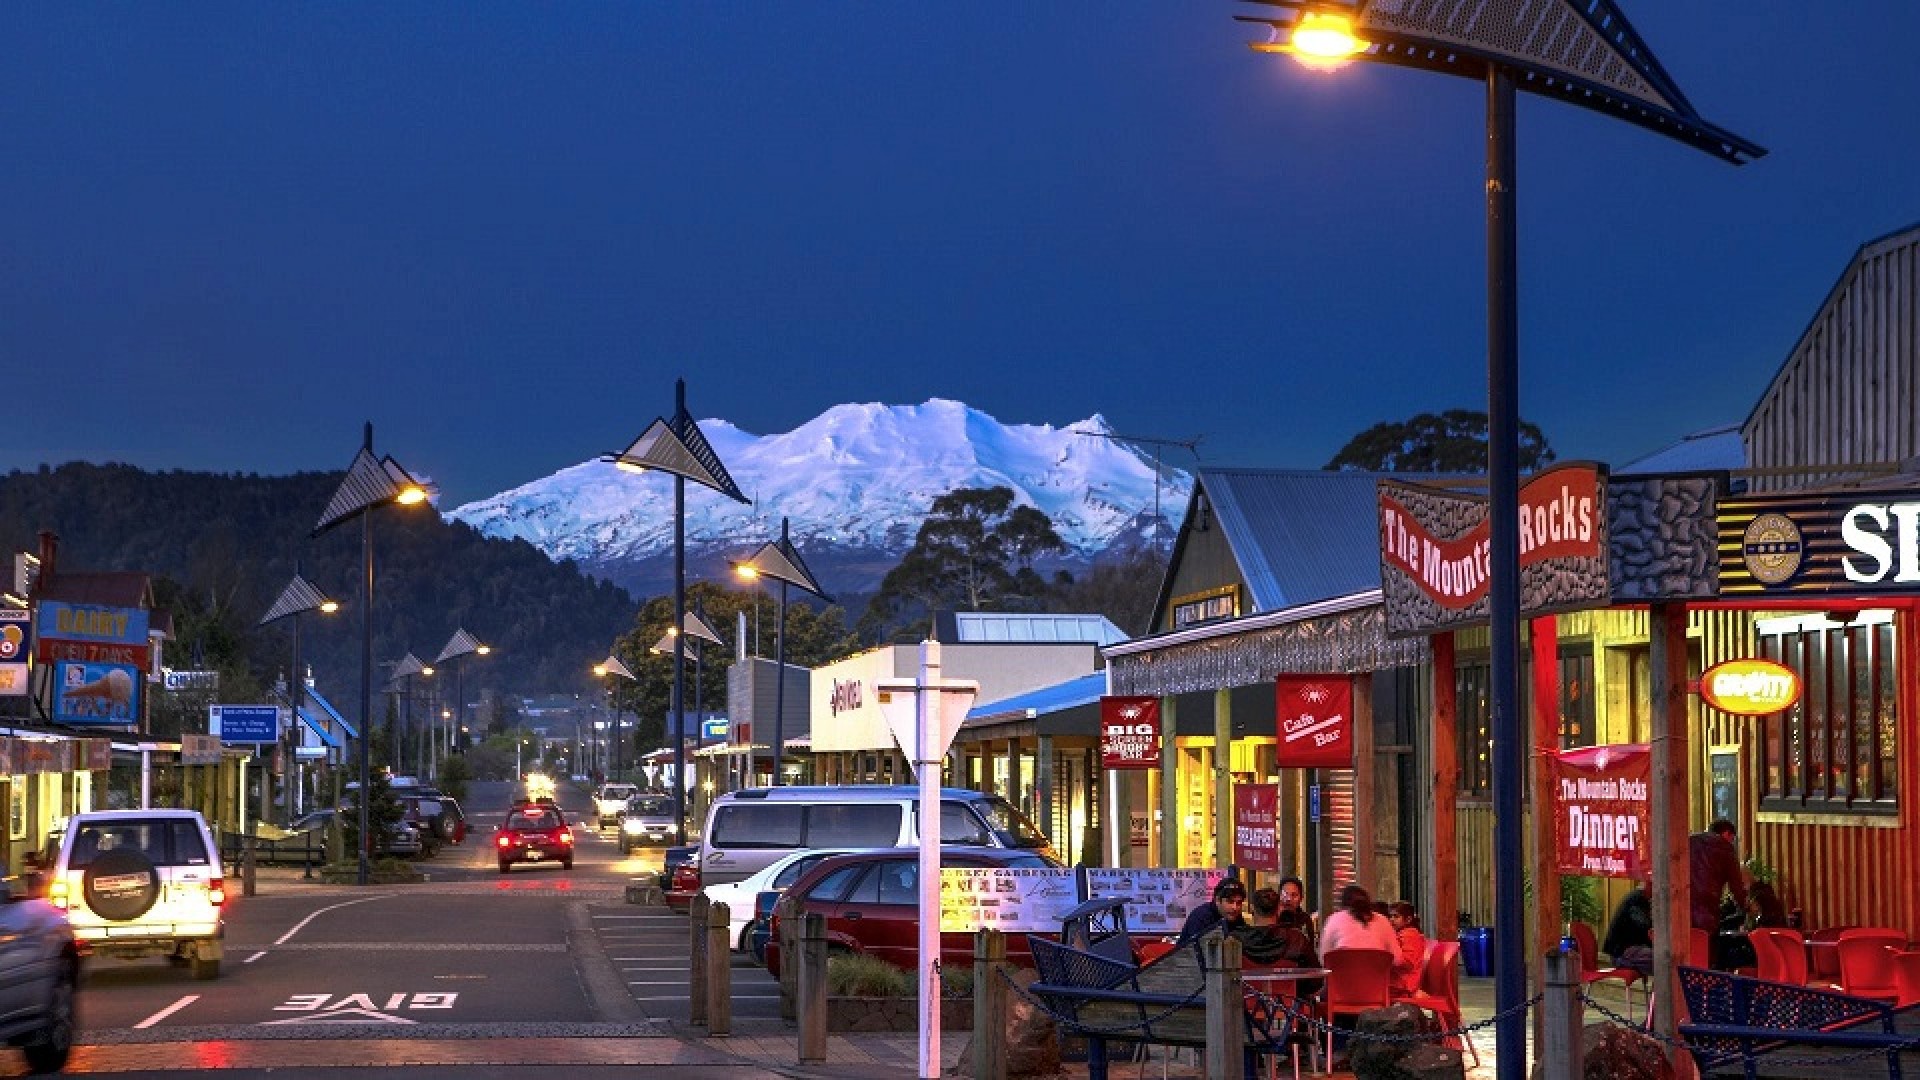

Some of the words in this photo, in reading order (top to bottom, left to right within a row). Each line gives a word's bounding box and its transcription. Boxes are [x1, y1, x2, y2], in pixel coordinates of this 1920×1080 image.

[1385, 509, 1418, 572] The
[1424, 537, 1490, 597] Mounta
[1519, 485, 1591, 554] Rocks
[56, 607, 128, 637] DAIRY
[1108, 724, 1152, 735] BIG
[1314, 731, 1341, 746] Bar
[1562, 777, 1577, 799] The
[1578, 778, 1618, 799] Mountain
[1620, 778, 1647, 800] Rocks
[1569, 805, 1638, 850] Dinner
[993, 869, 1071, 877] GARDENING
[1089, 869, 1141, 877] MARKET
[1147, 869, 1221, 877] GARDENING
[272, 992, 459, 1010] GIVE
